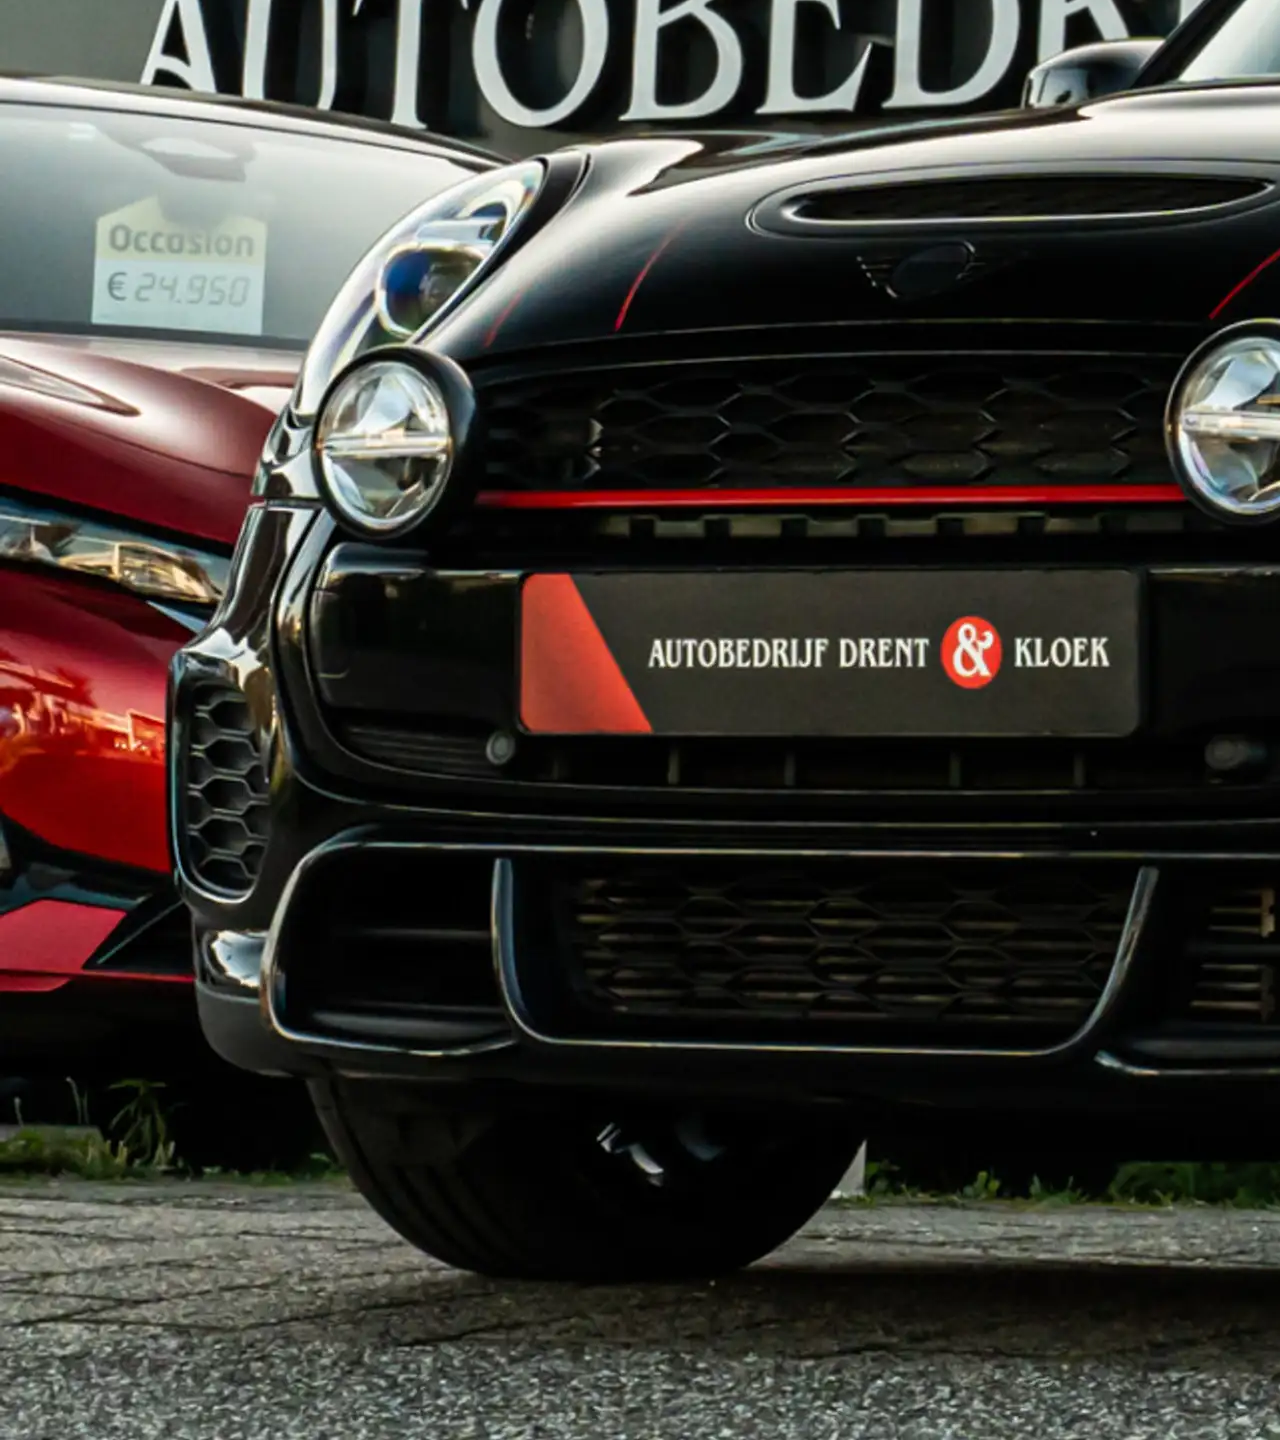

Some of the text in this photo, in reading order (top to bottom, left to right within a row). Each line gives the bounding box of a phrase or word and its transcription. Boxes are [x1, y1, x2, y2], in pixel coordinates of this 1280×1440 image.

[108, 223, 255, 258] Occasion
[107, 271, 252, 308] € 24.950
[648, 622, 1111, 678] AUTOBEDRIJF DRENT & KLOEK
